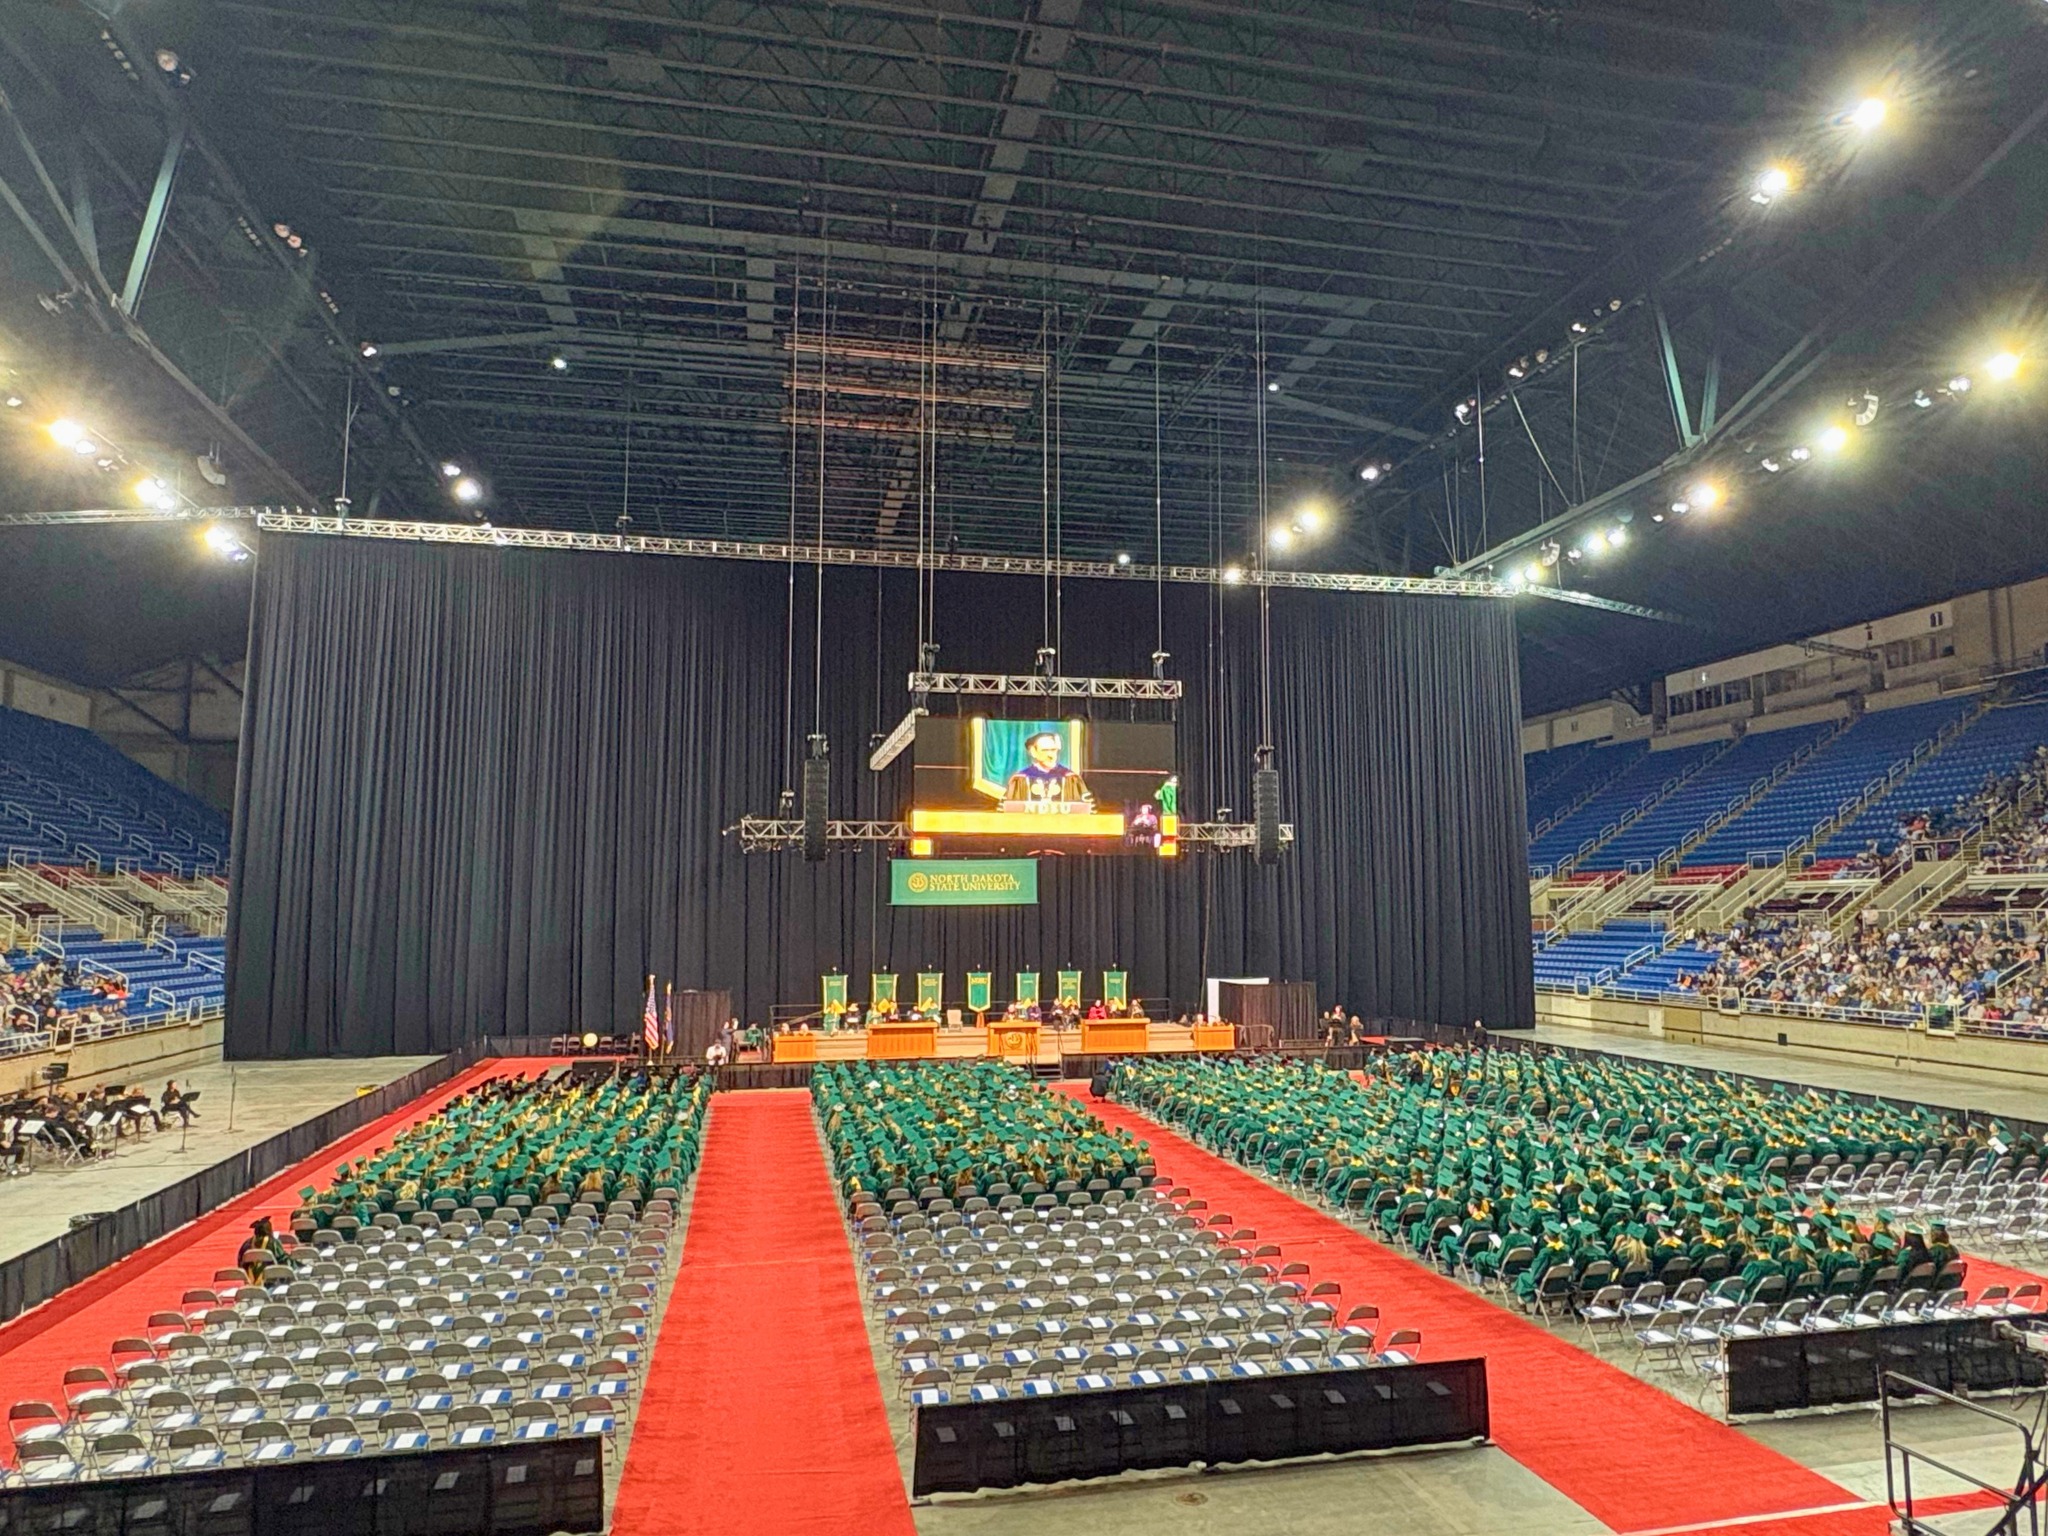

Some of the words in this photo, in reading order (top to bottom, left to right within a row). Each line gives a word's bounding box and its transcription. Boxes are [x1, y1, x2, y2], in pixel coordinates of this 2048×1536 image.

[929, 874, 968, 883] NORTH
[971, 873, 1014, 882] DAKOTA
[929, 882, 960, 891] STATE
[962, 881, 1020, 891] UNIVERSITY
